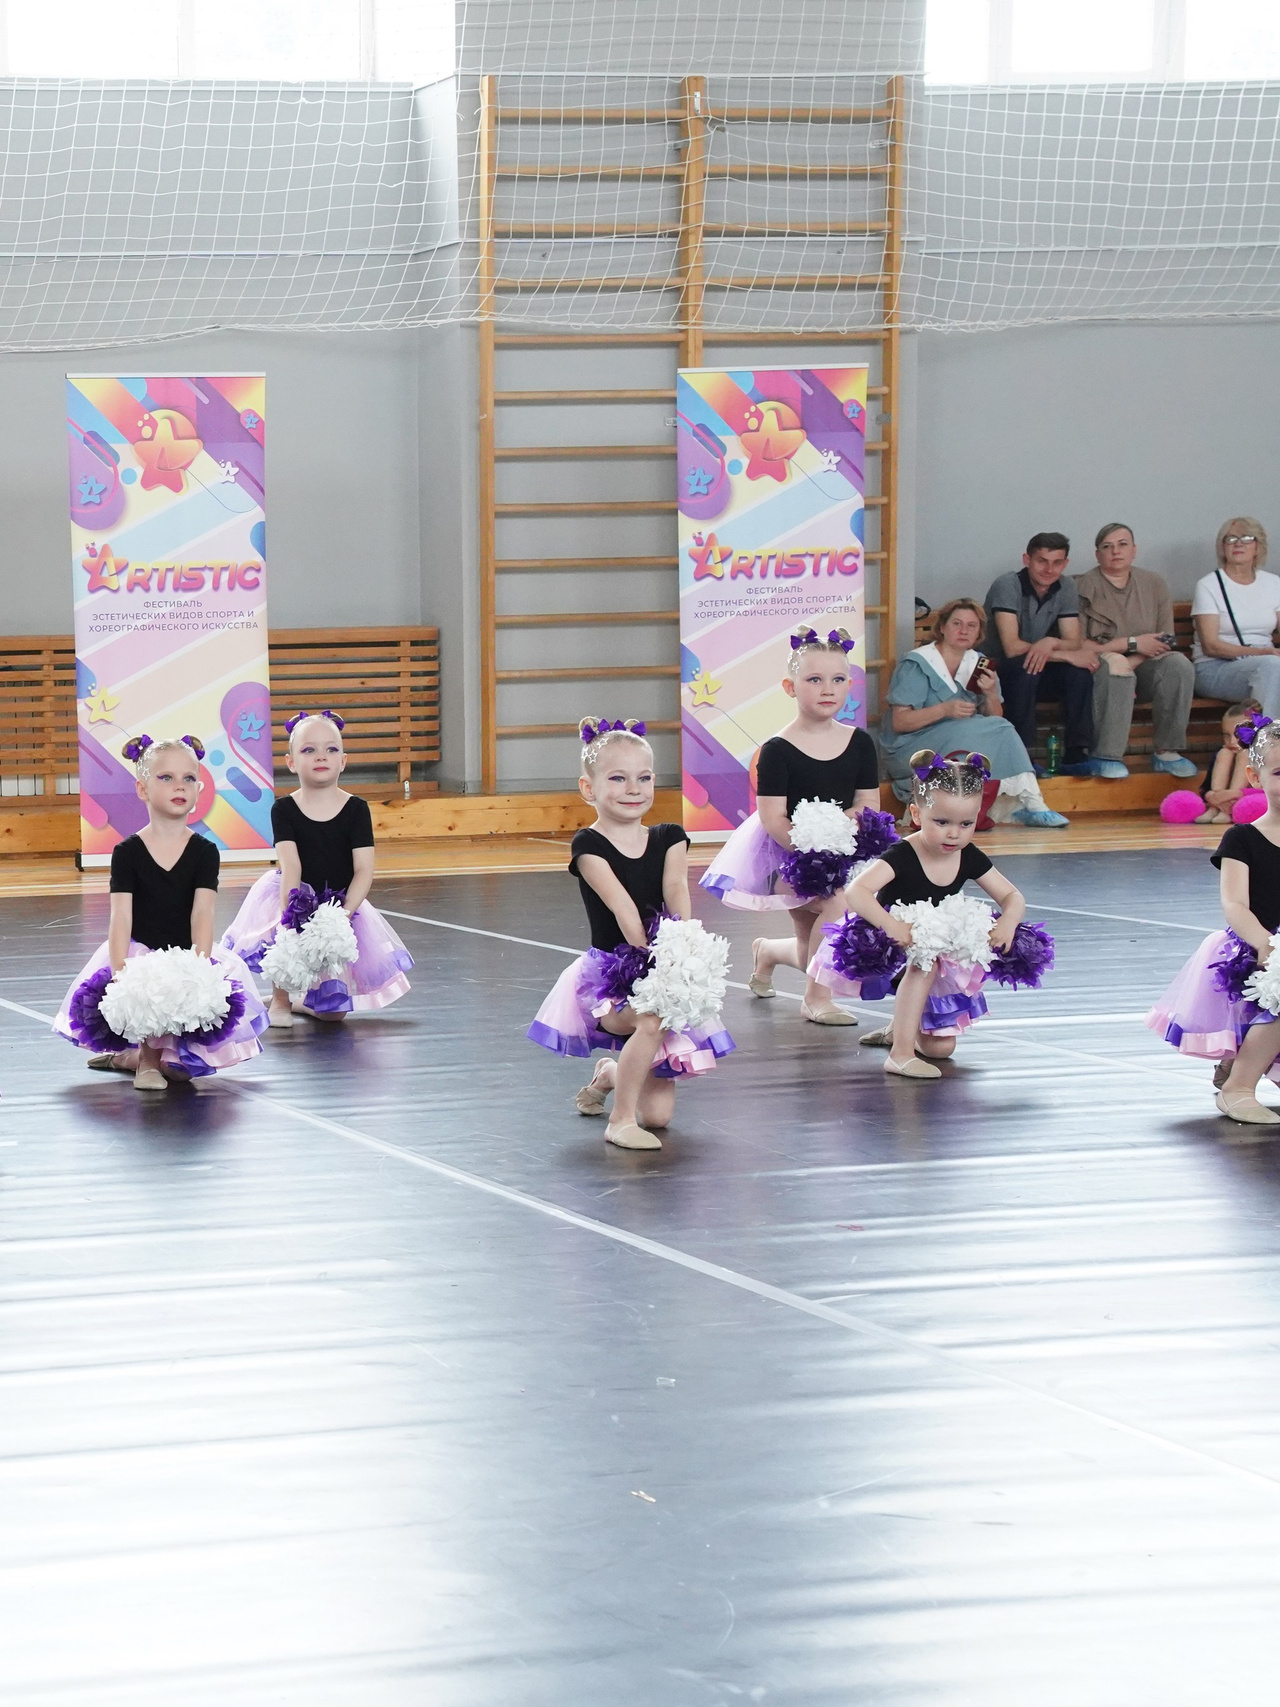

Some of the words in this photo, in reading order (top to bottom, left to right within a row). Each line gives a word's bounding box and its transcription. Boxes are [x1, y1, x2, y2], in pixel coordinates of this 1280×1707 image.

[746, 586, 803, 595] ФЕСТИВАЛЬ
[143, 600, 203, 609] ФЕСТИВАЛЬ
[697, 598, 768, 608] ЭСТЕТИЧЕСКИХ
[770, 597, 804, 606] ВИДОВ
[806, 595, 844, 604] СПОРТА
[92, 612, 167, 621] ЭСТЕТИЧЕСКИХ
[169, 611, 203, 621] ВИДОВ
[206, 610, 245, 619] СПОРТА
[247, 610, 254, 618] И
[694, 607, 799, 619] ХОРЕОГРАФИЧЕСКОГО
[801, 606, 857, 615] ИСКУССТВА
[88, 622, 199, 633] ХОРЕОГРАФИЧЕСКОГО
[202, 621, 259, 631] ИСКУССТВА
